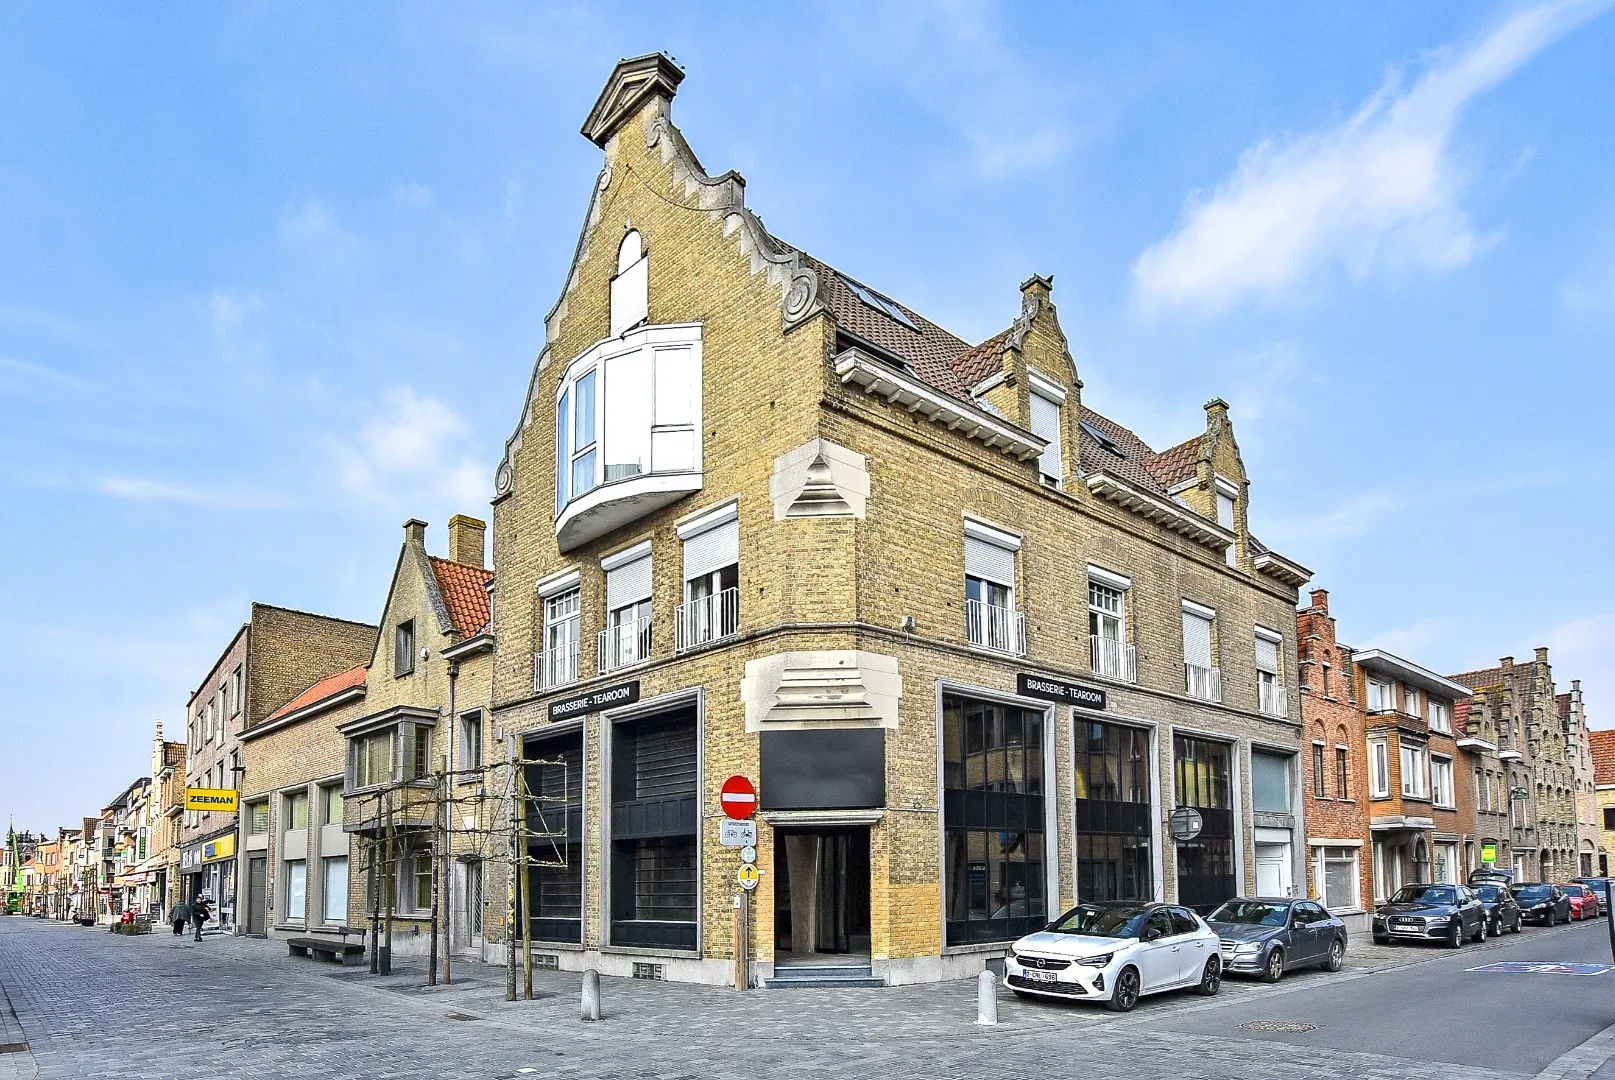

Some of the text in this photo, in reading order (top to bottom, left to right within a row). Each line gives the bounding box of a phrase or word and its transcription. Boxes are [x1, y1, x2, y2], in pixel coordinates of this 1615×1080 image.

[552, 697, 589, 715] BRASSERIE
[593, 687, 630, 705] TEAROOM
[1027, 679, 1065, 696] BRASSERIE
[1069, 687, 1102, 703] TEAROOM
[190, 795, 234, 804] ZEEMAN
